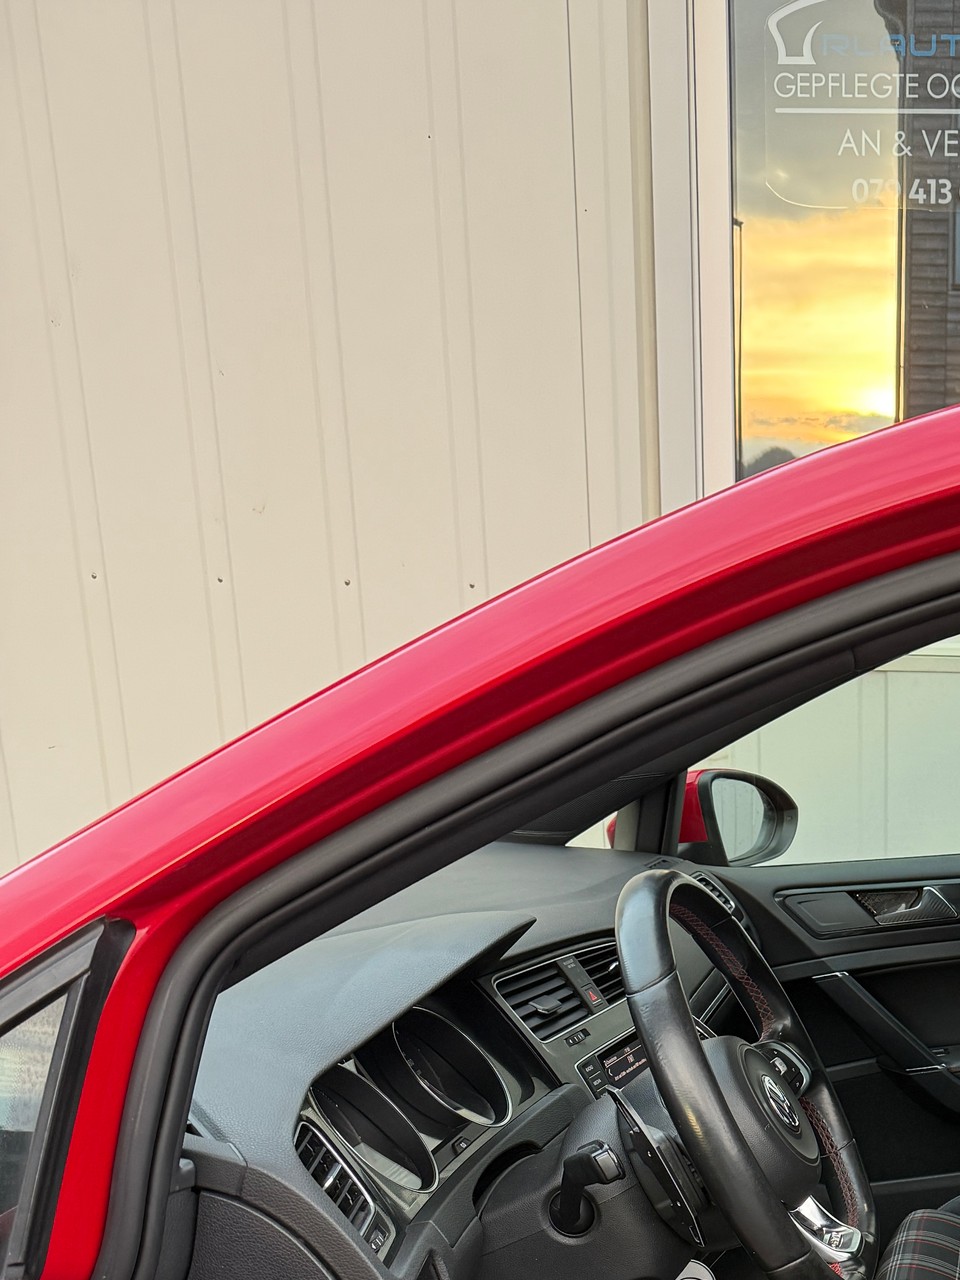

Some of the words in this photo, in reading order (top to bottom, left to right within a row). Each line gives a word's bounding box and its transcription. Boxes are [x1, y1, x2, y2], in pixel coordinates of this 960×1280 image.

[773, 72, 919, 98] GEPFLEGTE
[837, 128, 881, 157] AN
[892, 130, 912, 157] &
[908, 178, 952, 205] 413
